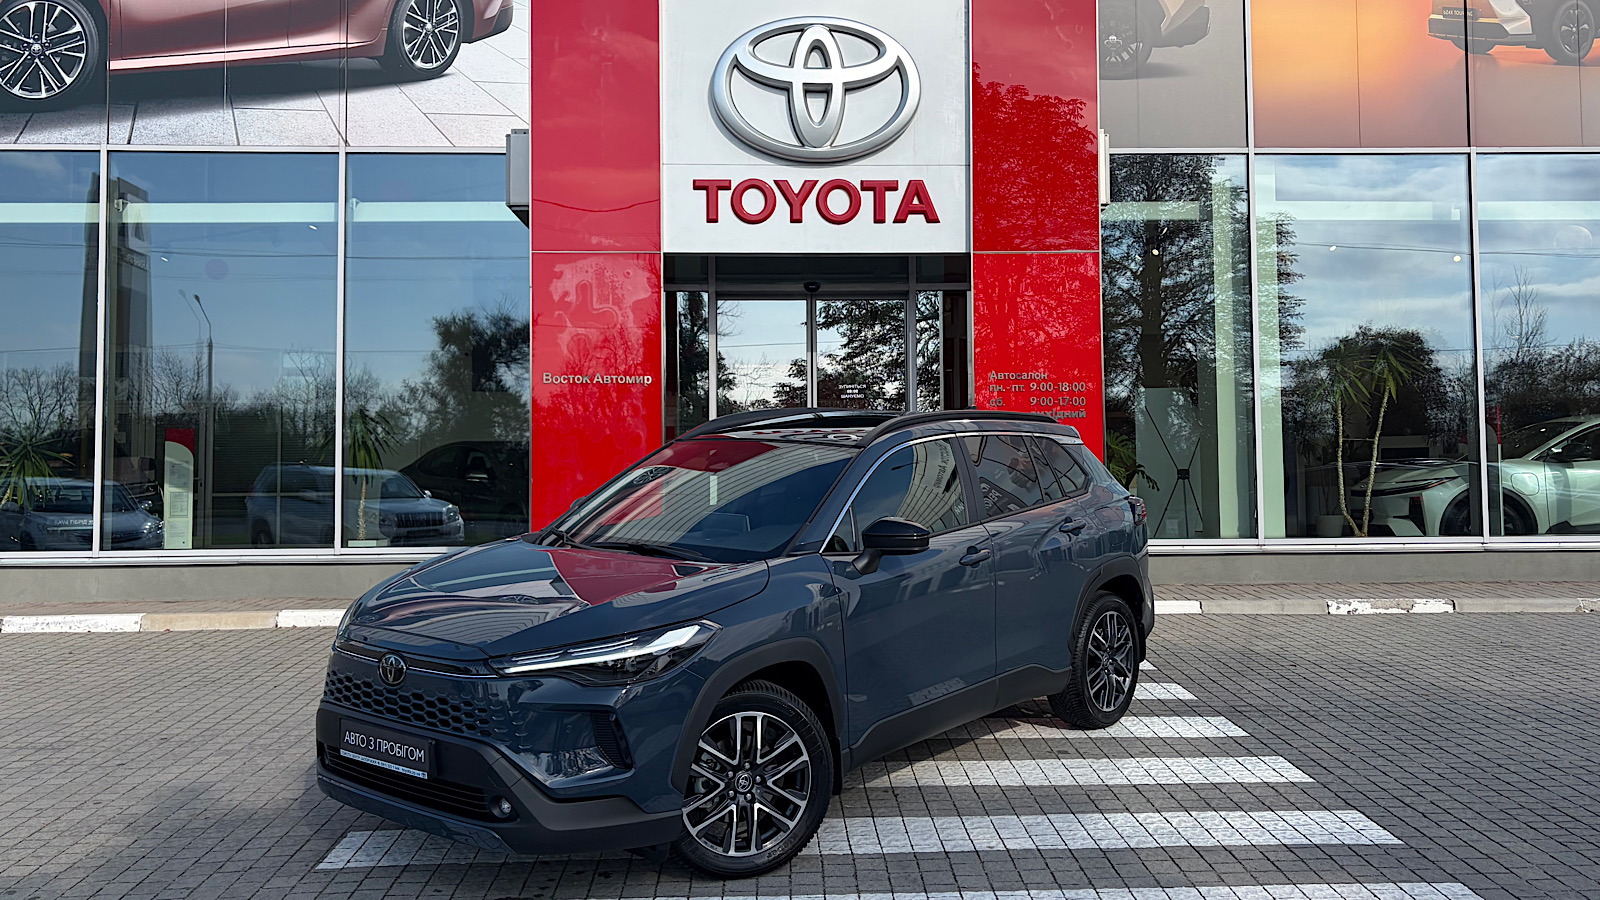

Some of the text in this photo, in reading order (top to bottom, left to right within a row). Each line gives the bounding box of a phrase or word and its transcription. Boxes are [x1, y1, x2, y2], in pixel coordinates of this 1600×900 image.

[693, 178, 940, 225] TOYOTA
[542, 372, 652, 386] Восток Автомир
[989, 370, 1048, 380] Автосалон
[989, 397, 1006, 407] сб.
[344, 730, 425, 763] АВТО З ПРОБІГОМ
